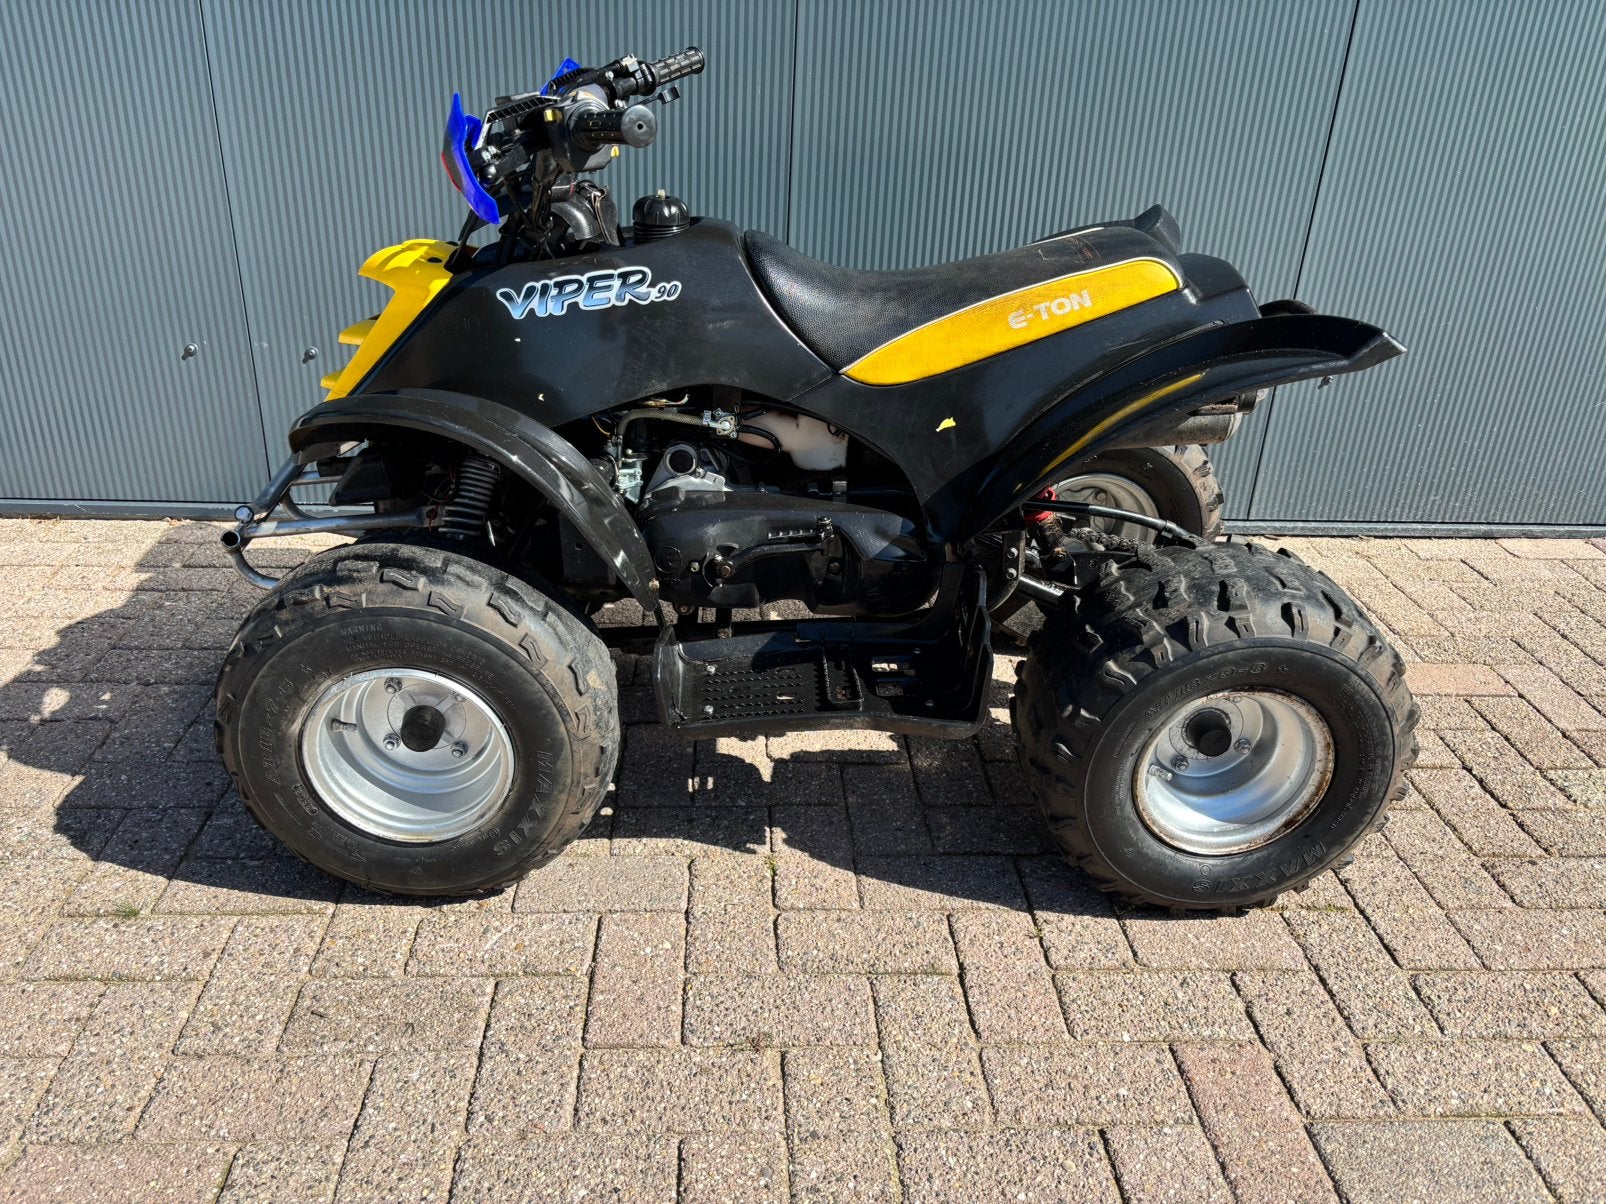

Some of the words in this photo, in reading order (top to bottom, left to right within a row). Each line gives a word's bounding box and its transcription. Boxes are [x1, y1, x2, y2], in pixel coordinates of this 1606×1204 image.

[497, 267, 652, 319] VIPER
[655, 282, 681, 301] 90
[1008, 289, 1092, 329] E-TON
[340, 623, 383, 636] WARNING
[492, 750, 555, 856] MAXXIS
[1191, 840, 1328, 894] MAXXIS
